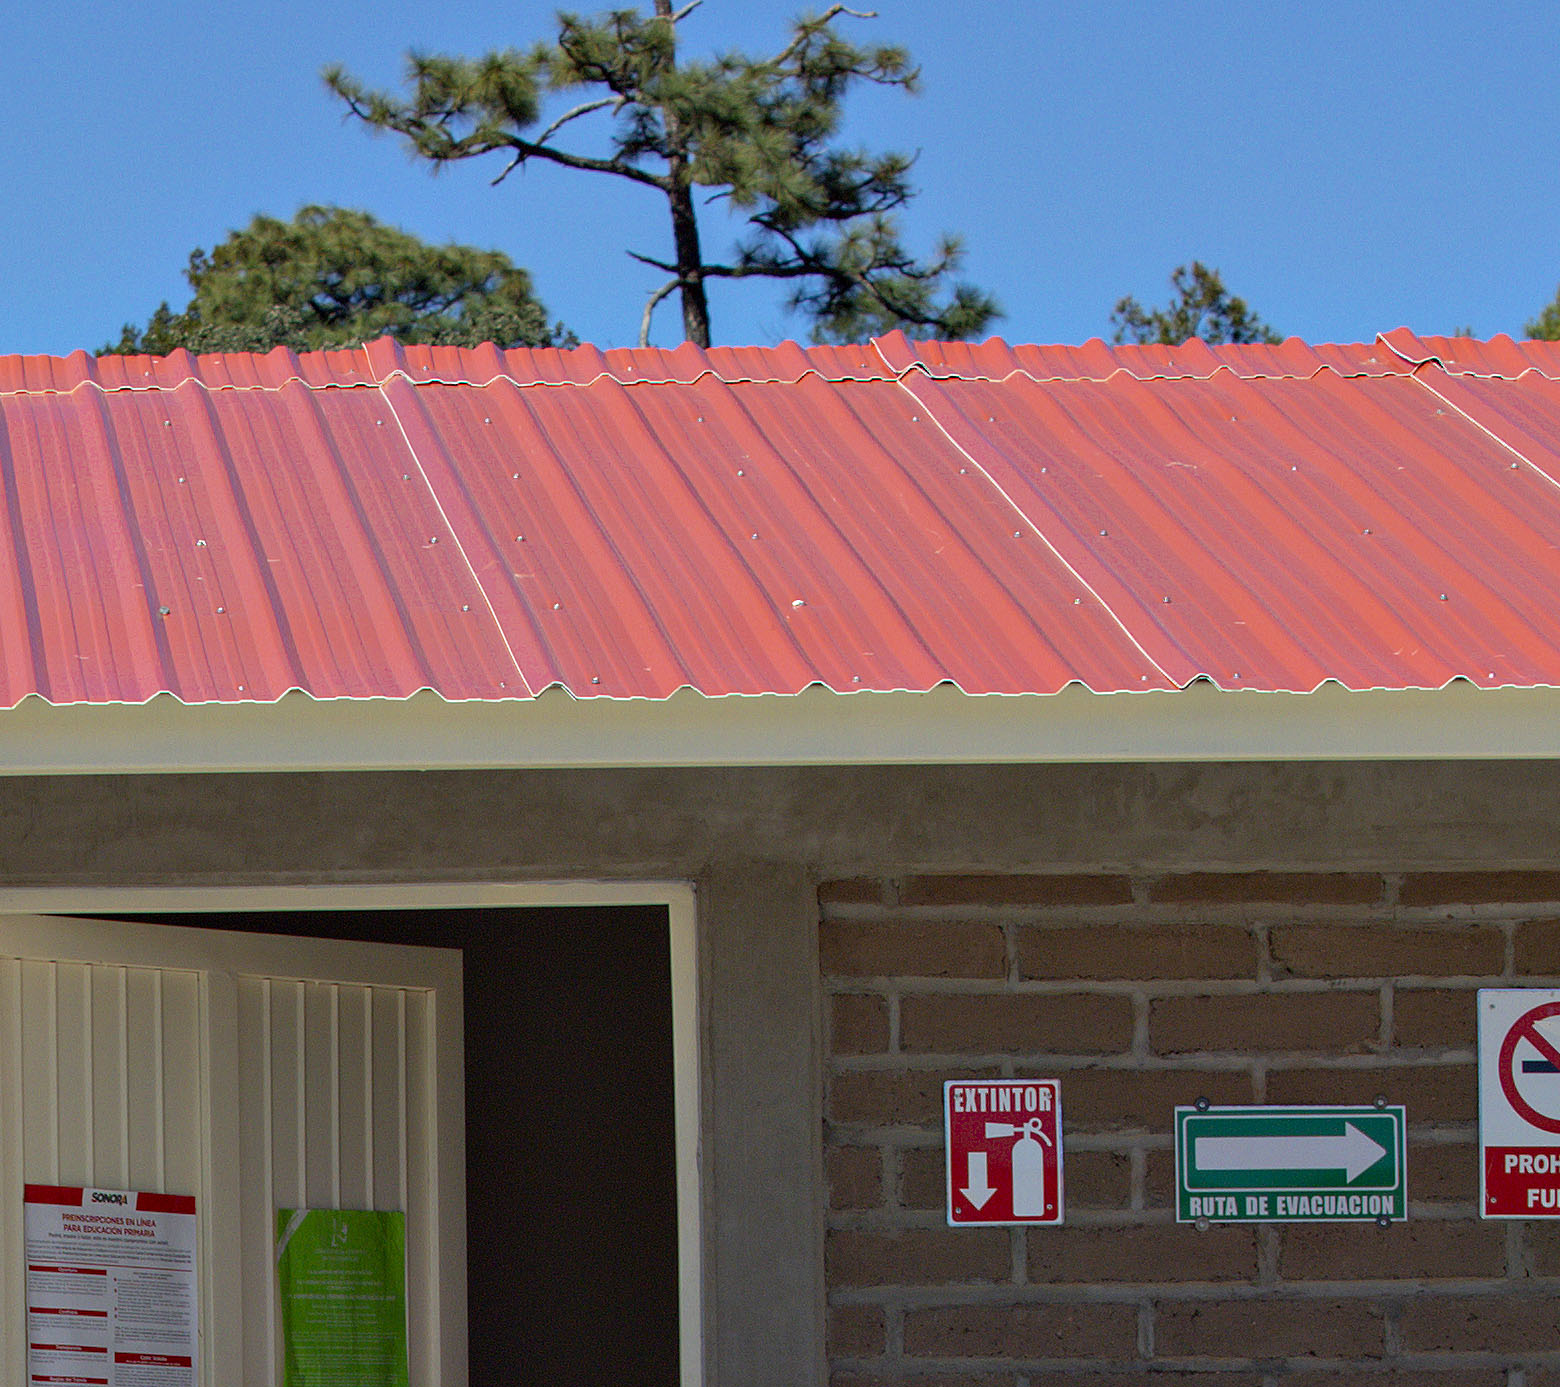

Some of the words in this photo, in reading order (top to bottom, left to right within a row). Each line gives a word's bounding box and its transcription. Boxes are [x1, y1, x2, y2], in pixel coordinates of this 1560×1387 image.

[953, 1087, 1052, 1114] EXTINTOR
[91, 1191, 129, 1206] SONORA
[1189, 1194, 1238, 1217] RUTA
[1245, 1194, 1269, 1216] DE
[1276, 1193, 1395, 1217] EVACUACION
